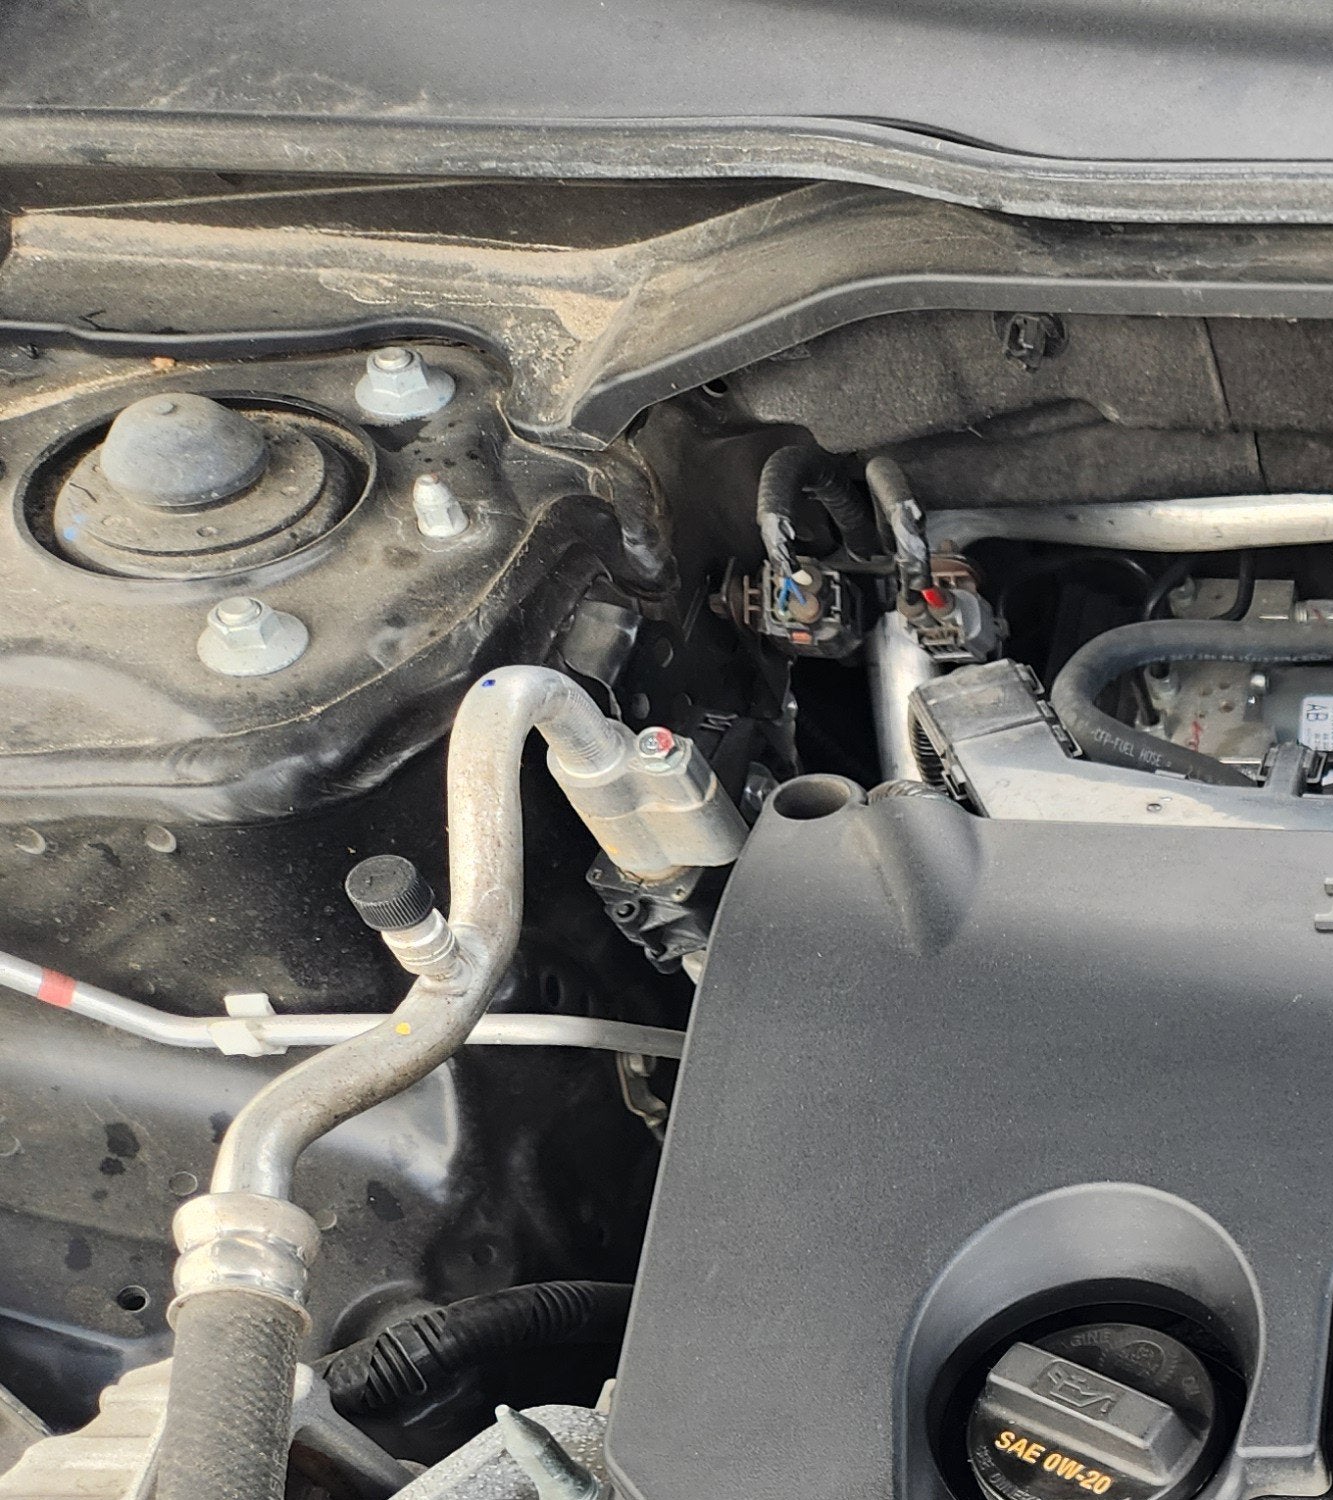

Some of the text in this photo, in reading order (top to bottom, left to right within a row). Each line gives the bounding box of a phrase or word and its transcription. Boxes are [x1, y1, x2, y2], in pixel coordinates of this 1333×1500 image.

[1307, 703, 1329, 721] AB
[995, 1430, 1113, 1495] SAE 0W-20
